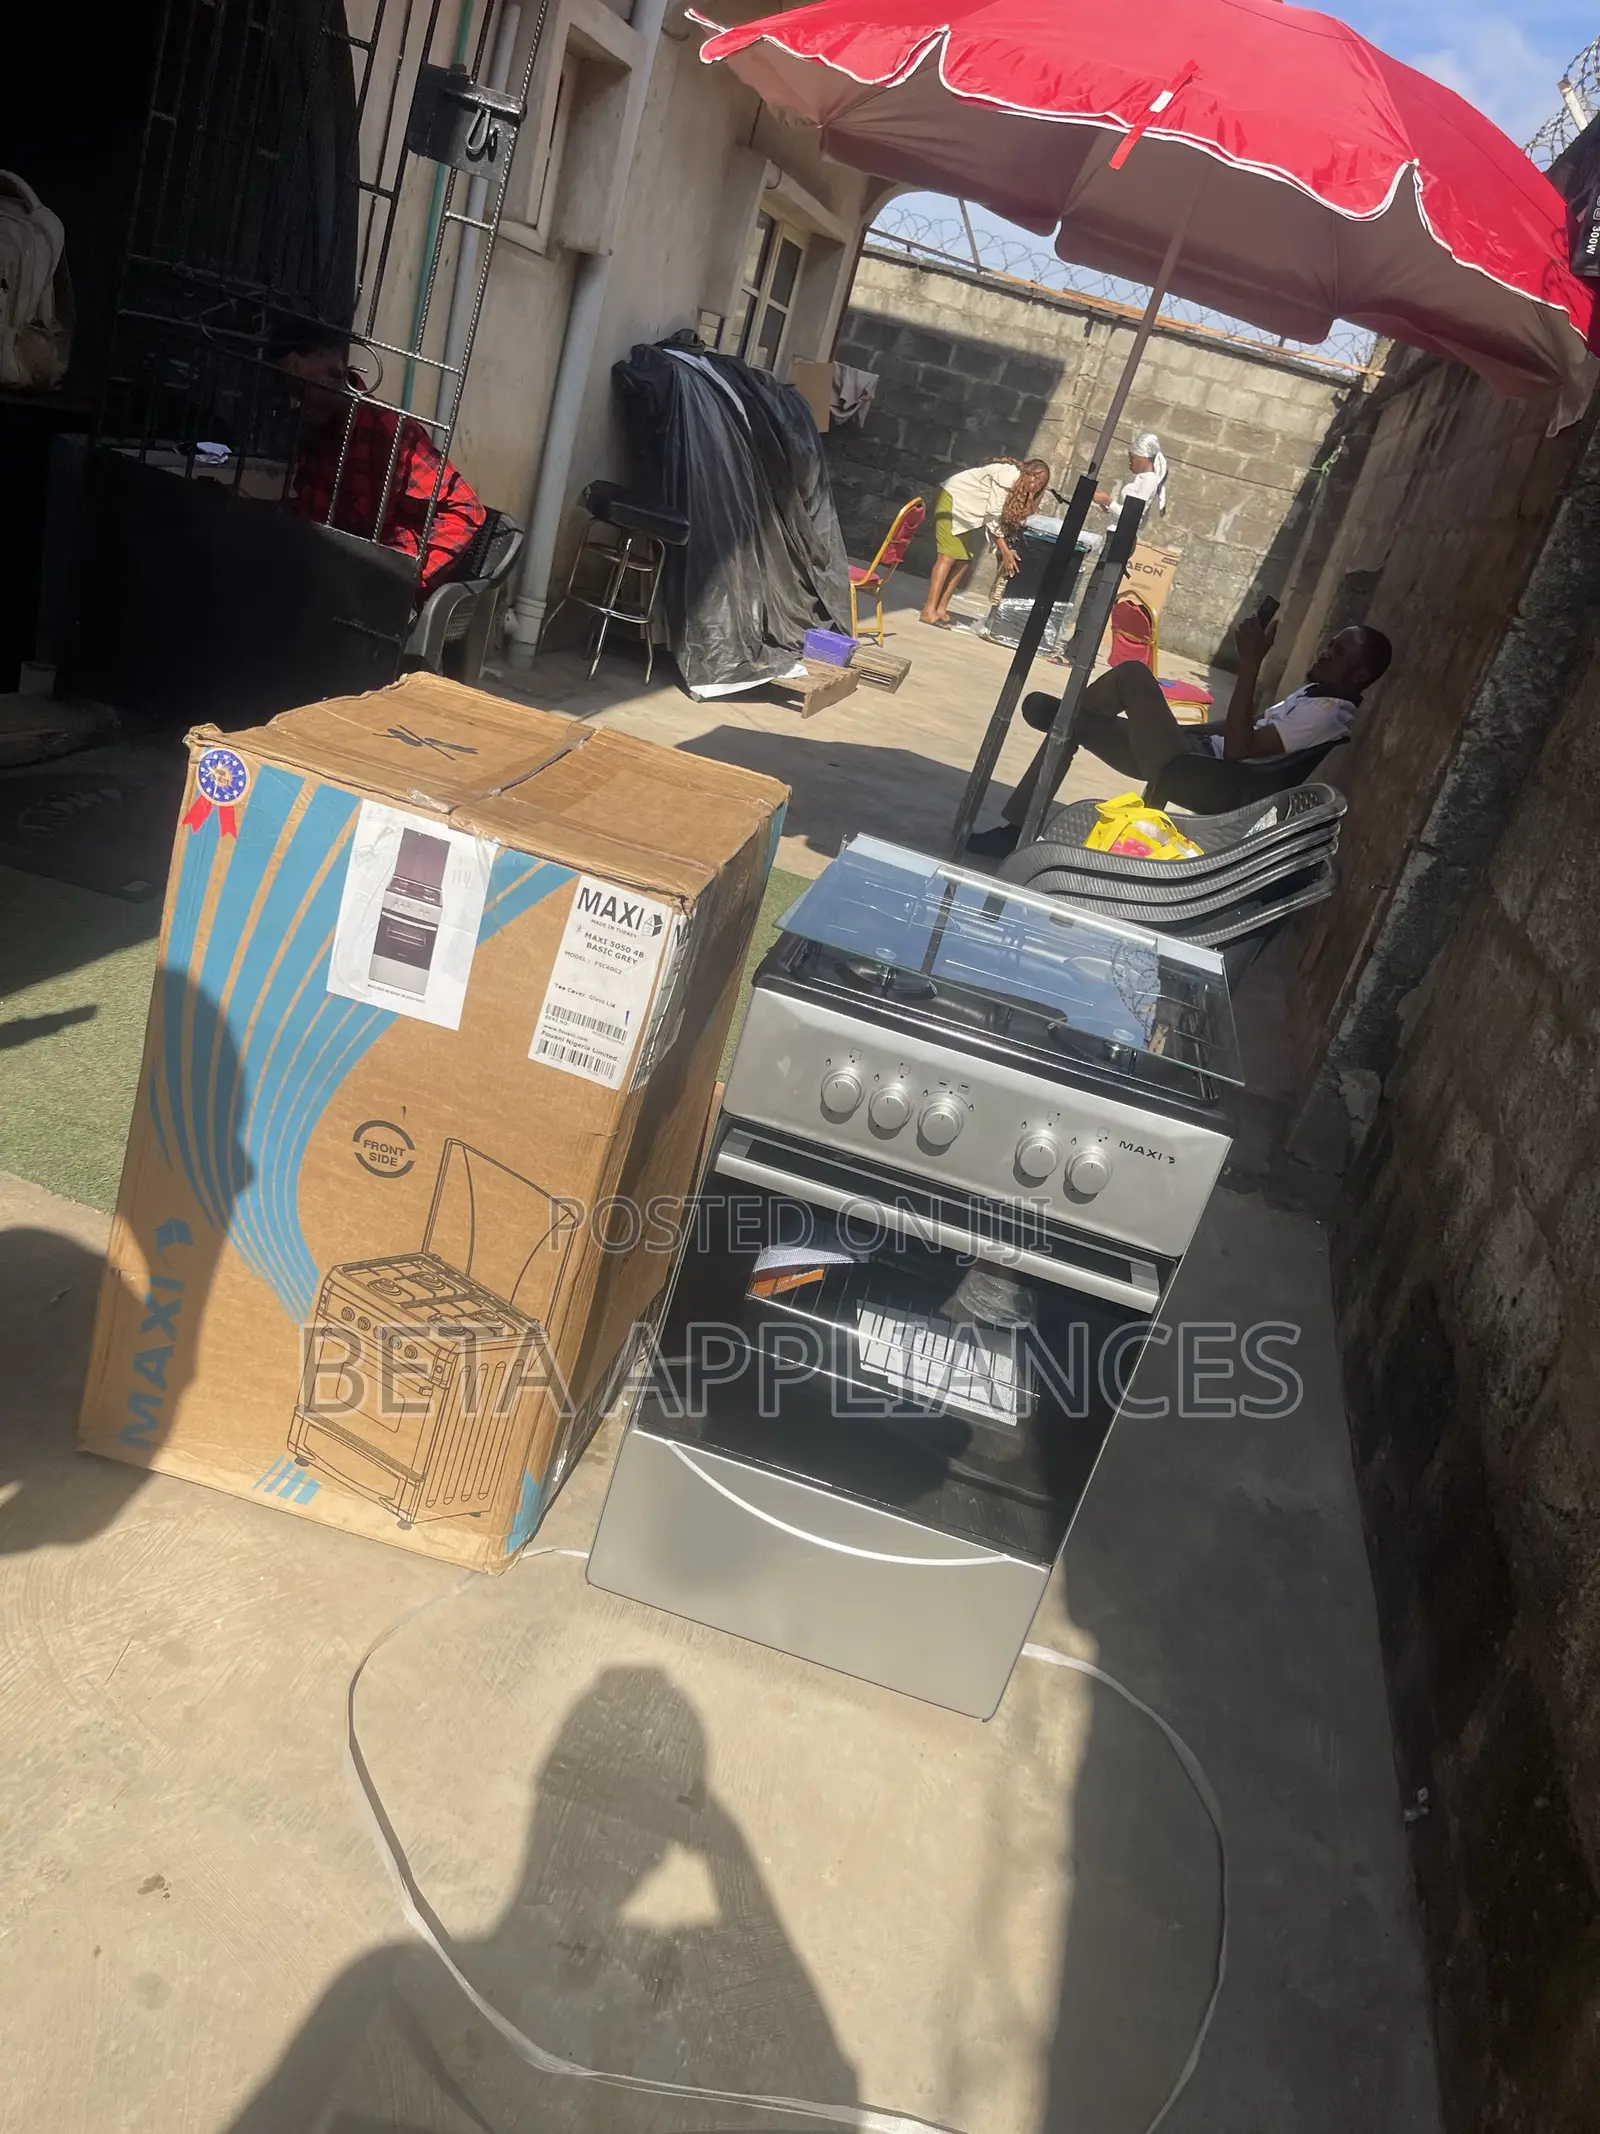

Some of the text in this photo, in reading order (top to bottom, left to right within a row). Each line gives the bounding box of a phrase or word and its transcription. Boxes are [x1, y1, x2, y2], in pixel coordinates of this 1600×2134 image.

[577, 887, 645, 931] MAXI
[591, 919, 606, 929] MADE
[616, 927, 637, 938] TURKEY
[584, 932, 608, 945] MAXI
[609, 940, 632, 954] 5050
[586, 941, 638, 965] BASIC GREY
[564, 950, 586, 963] MODEL
[567, 987, 585, 997] Cover
[541, 1030, 565, 1042] Fouani
[566, 1038, 591, 1051] Nigeria
[363, 1139, 406, 1157] FRONT
[1119, 1140, 1163, 1160] MAXI
[369, 1152, 398, 1167] SIDE
[119, 1274, 186, 1450] MAXI
